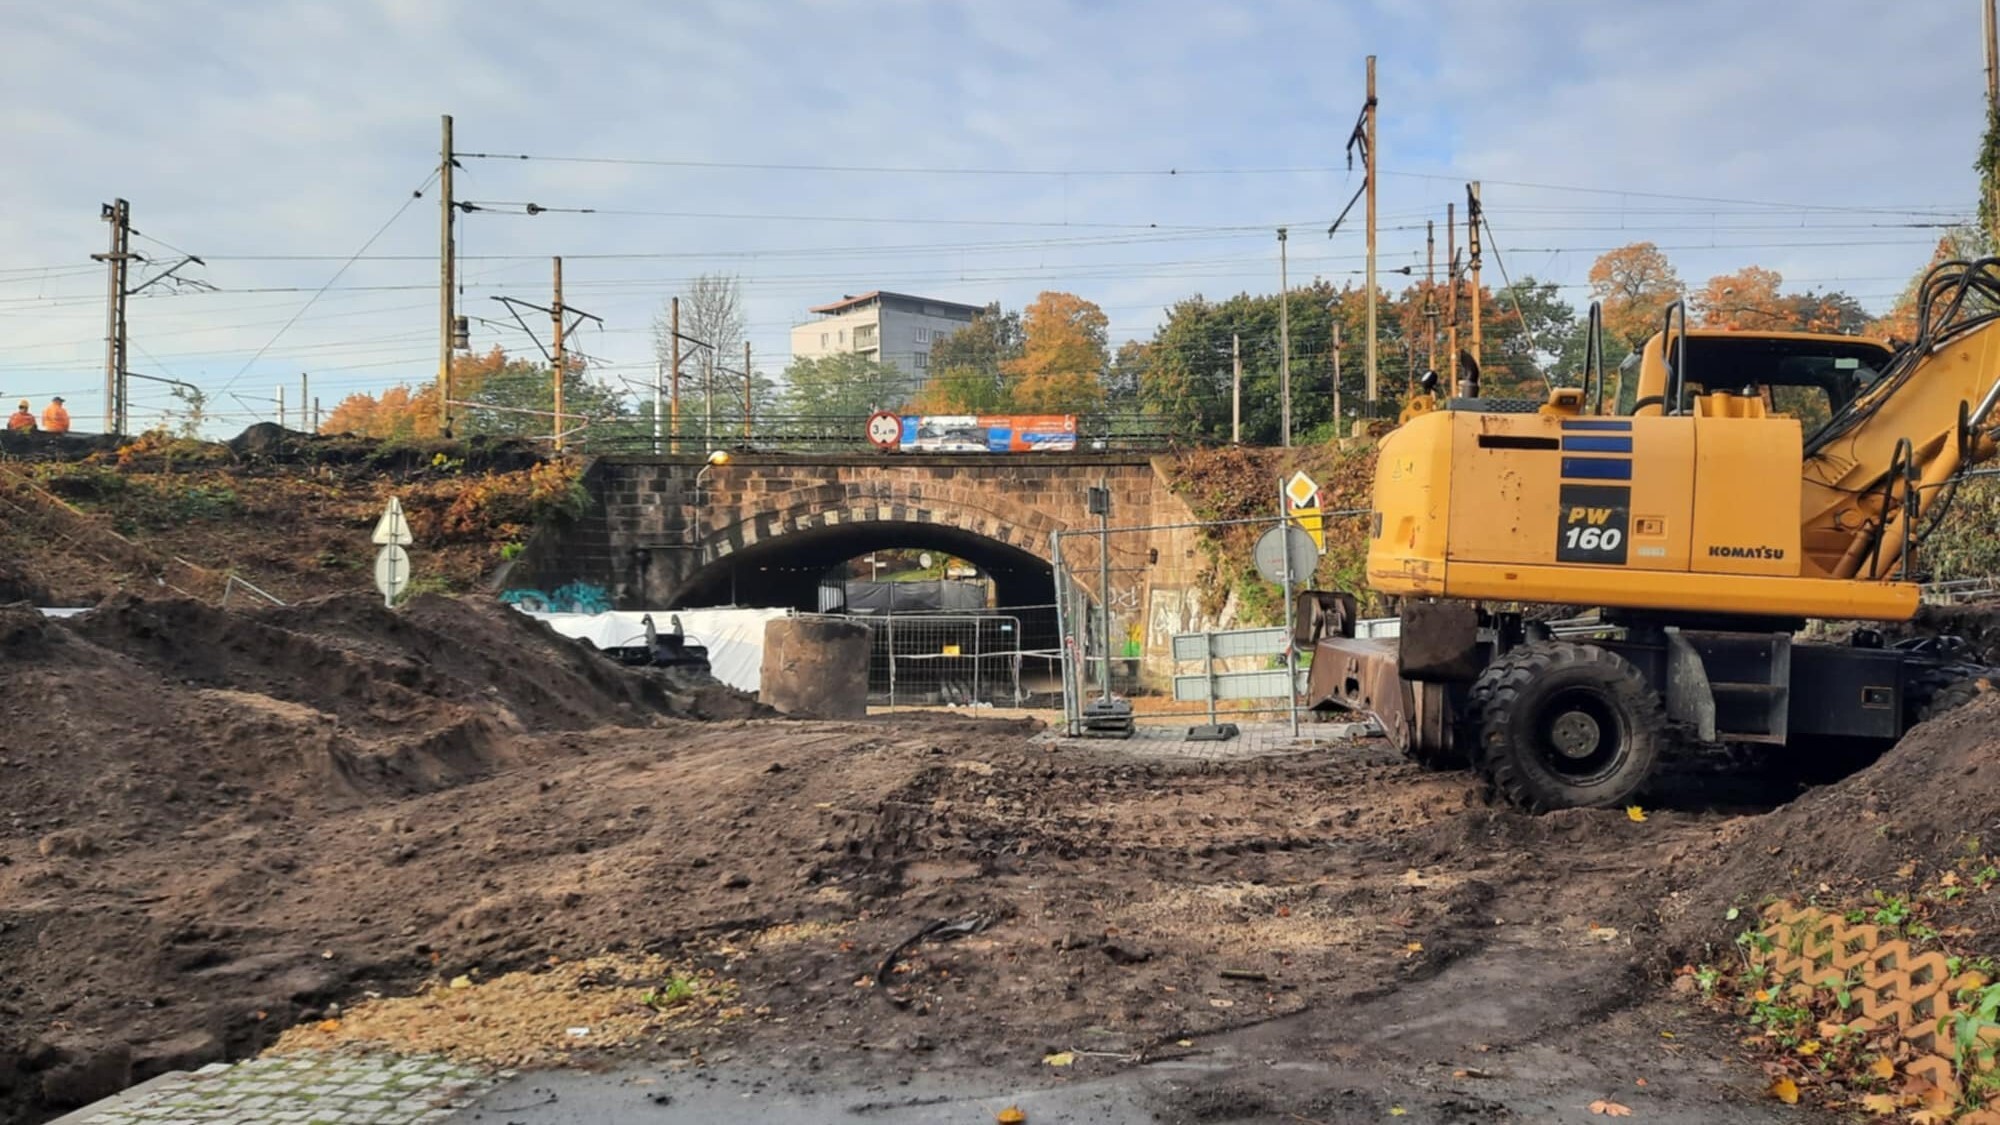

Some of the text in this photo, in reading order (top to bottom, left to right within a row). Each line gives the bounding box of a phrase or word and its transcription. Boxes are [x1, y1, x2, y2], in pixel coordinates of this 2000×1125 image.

[1567, 507, 1612, 525] PW
[1566, 527, 1622, 551] 160
[1708, 545, 1785, 560] KOMATSU
